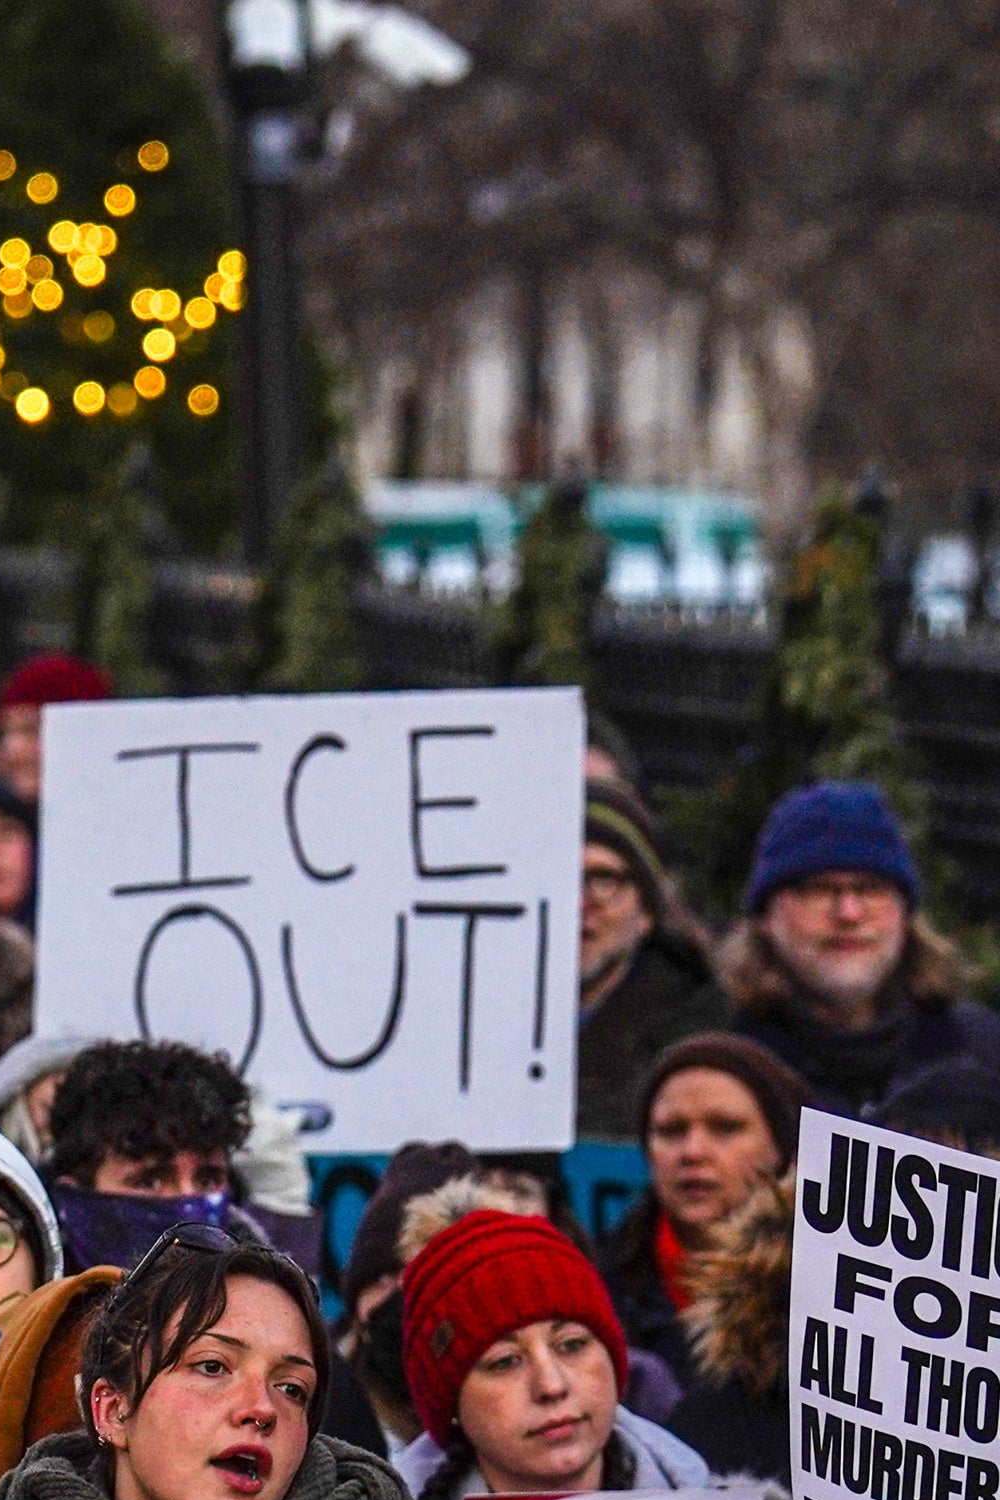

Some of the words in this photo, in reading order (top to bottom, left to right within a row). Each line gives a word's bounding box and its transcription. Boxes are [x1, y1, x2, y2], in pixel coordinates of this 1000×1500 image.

[111, 726, 508, 896] ICE
[134, 898, 551, 1094] OUT!
[802, 1132, 1000, 1280] JUSTI
[799, 1316, 884, 1416] ALL
[900, 1345, 1000, 1444] THO
